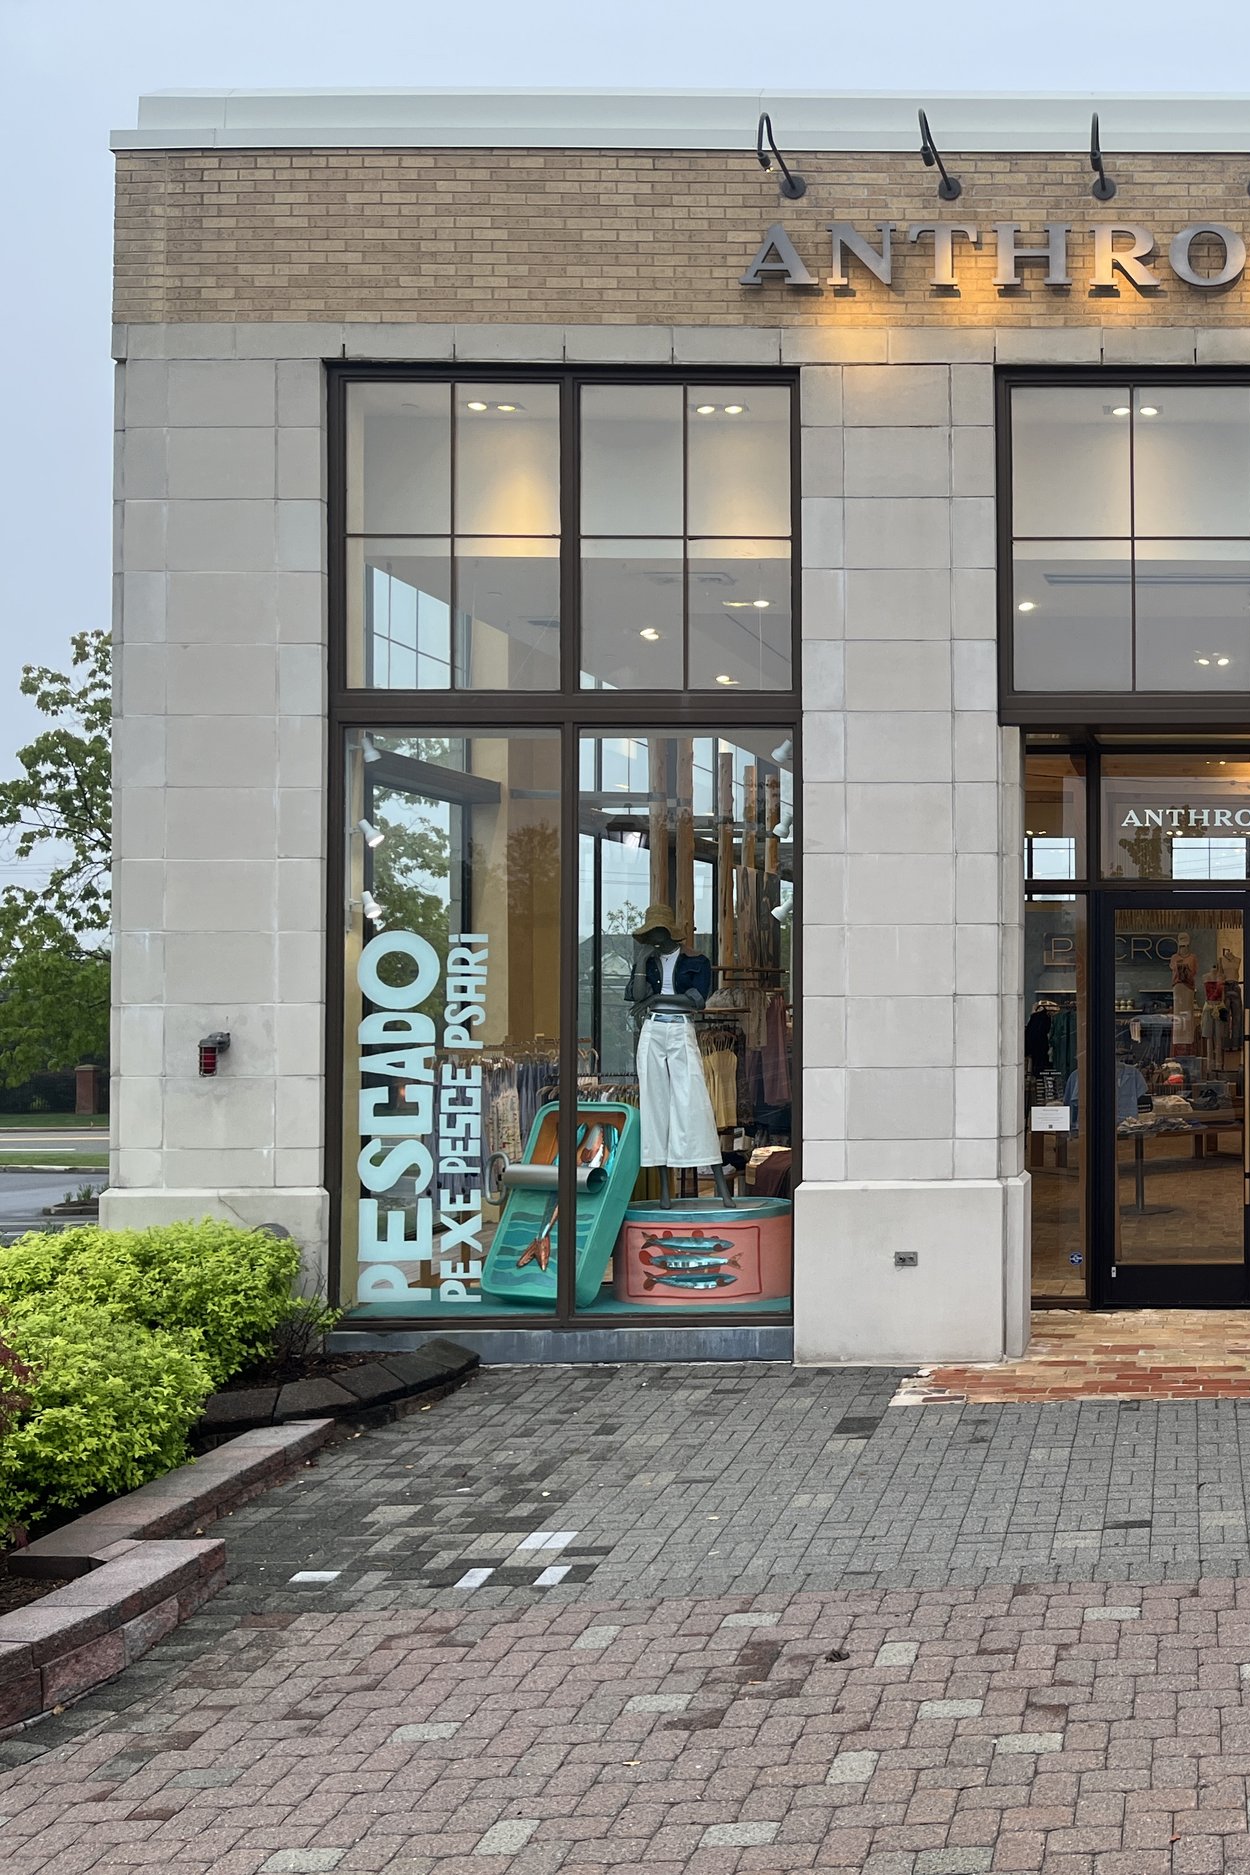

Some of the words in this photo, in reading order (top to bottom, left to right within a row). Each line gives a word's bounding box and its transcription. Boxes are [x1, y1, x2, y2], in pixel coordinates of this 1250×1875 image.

[357, 930, 441, 1303] PESCADO
[438, 1064, 482, 1175] PESCE
[439, 1188, 483, 1303] PEXE
